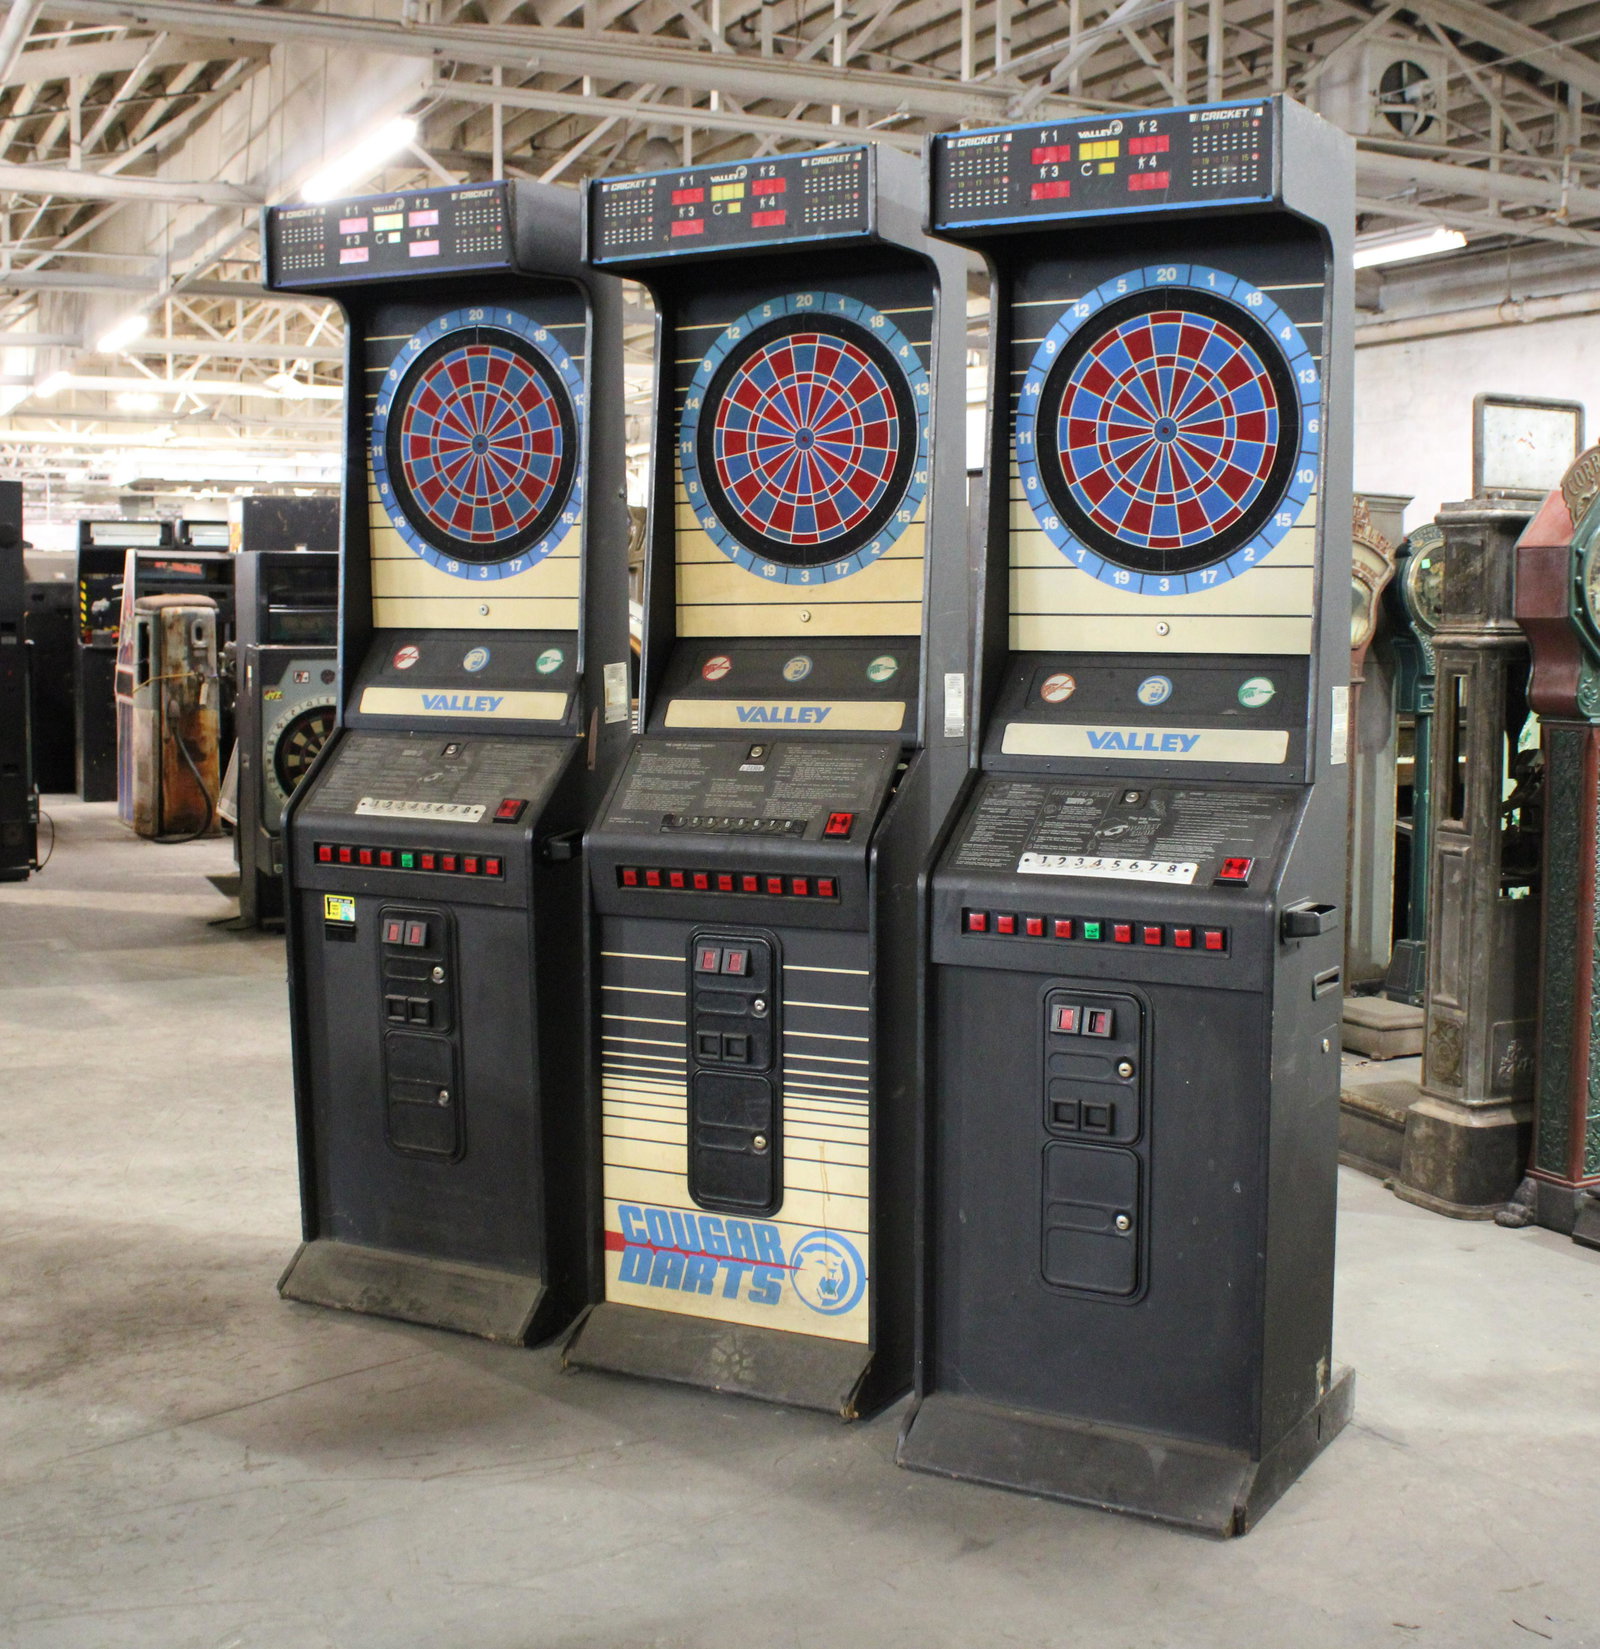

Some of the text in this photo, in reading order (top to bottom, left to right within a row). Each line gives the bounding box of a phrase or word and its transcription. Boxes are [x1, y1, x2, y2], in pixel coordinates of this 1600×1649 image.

[1201, 108, 1250, 121] CRICKET
[1149, 120, 1158, 132] 2
[1052, 130, 1058, 142] 1
[1078, 129, 1110, 139] VALLEY
[958, 135, 1001, 147] CRICKET
[811, 153, 851, 166] CRICKET
[1149, 156, 1157, 167] 4
[769, 165, 775, 176] 2
[1051, 166, 1059, 177] 3
[610, 179, 646, 191] CRICKET
[690, 175, 694, 186] 1
[768, 196, 776, 206] 4
[688, 206, 695, 217] 3
[1157, 268, 1176, 281] 20
[1208, 273, 1215, 286] 1
[1117, 279, 1127, 293] 5
[796, 294, 812, 307] 20
[839, 299, 844, 310] 1
[1245, 292, 1262, 306] 18
[469, 309, 484, 320] 20
[762, 305, 771, 317] 5
[1073, 304, 1089, 317] 12
[440, 318, 448, 330] 5
[506, 314, 512, 324] 1
[870, 315, 884, 328] 18
[534, 329, 546, 341] 18
[726, 327, 740, 338] 12
[1281, 326, 1292, 340] 4
[409, 339, 420, 349] 12
[1046, 340, 1056, 353] 9
[900, 346, 908, 357] 4
[560, 358, 568, 369] 4
[704, 360, 712, 372] 9
[390, 369, 398, 380] 9
[1298, 369, 1316, 383] 13
[914, 383, 928, 394] 13
[1026, 382, 1040, 394] 14
[686, 398, 700, 409] 14
[375, 405, 387, 415] 14
[1308, 419, 1319, 432] 6
[1018, 432, 1031, 444] 11
[372, 447, 382, 456] 11
[681, 443, 692, 453] 11
[914, 472, 927, 484] 10
[1296, 470, 1312, 483] 10
[381, 483, 388, 494] 8
[690, 482, 697, 493] 8
[1028, 476, 1037, 490] 8
[393, 516, 406, 527] 16
[562, 513, 574, 523] 15
[896, 510, 910, 522] 15
[1274, 513, 1292, 527] 15
[703, 517, 717, 528] 16
[1042, 516, 1058, 529] 16
[419, 544, 426, 555] 7
[540, 542, 548, 552] 2
[732, 546, 739, 557] 7
[871, 541, 880, 554] 2
[1077, 550, 1086, 562] 7
[1244, 548, 1255, 561] 2
[446, 561, 459, 572] 19
[510, 560, 522, 571] 17
[762, 564, 776, 576] 19
[835, 562, 848, 574] 17
[480, 566, 488, 578] 3
[801, 570, 810, 582] 3
[1113, 571, 1130, 584] 19
[1200, 570, 1218, 584] 17
[1159, 578, 1170, 592] 3
[422, 694, 504, 712] VALLEY
[736, 706, 832, 723] VALLEY
[1086, 731, 1200, 752] VALLEY
[1058, 857, 1066, 865] 2
[1076, 857, 1084, 865] 3
[1093, 859, 1102, 867] 4
[1129, 862, 1139, 870] 6
[1167, 865, 1177, 873] 8
[618, 1204, 787, 1266] COUGAR
[618, 1244, 787, 1306] DARTS
